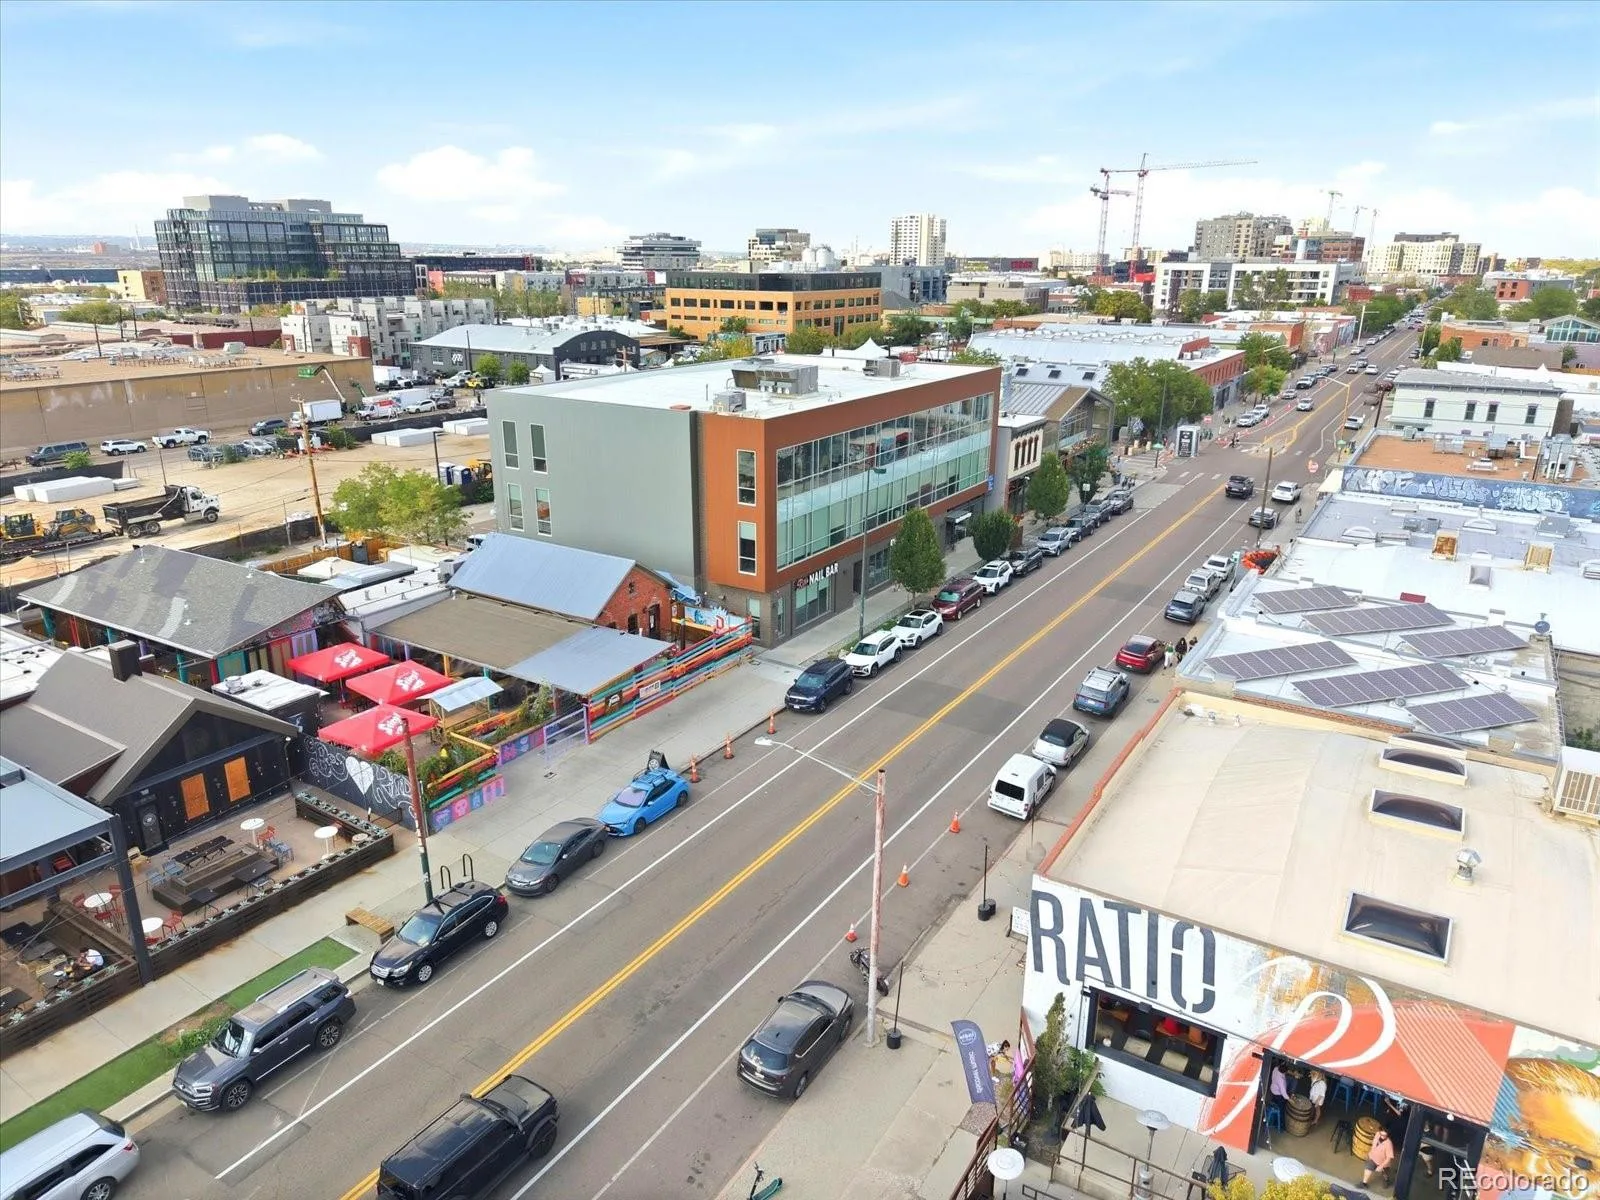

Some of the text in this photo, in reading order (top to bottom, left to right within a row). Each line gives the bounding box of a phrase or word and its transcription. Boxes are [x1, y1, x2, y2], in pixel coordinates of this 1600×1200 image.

[809, 569, 824, 585] NAIL
[825, 562, 839, 578] BAR
[1030, 889, 1216, 1014] RATIO
